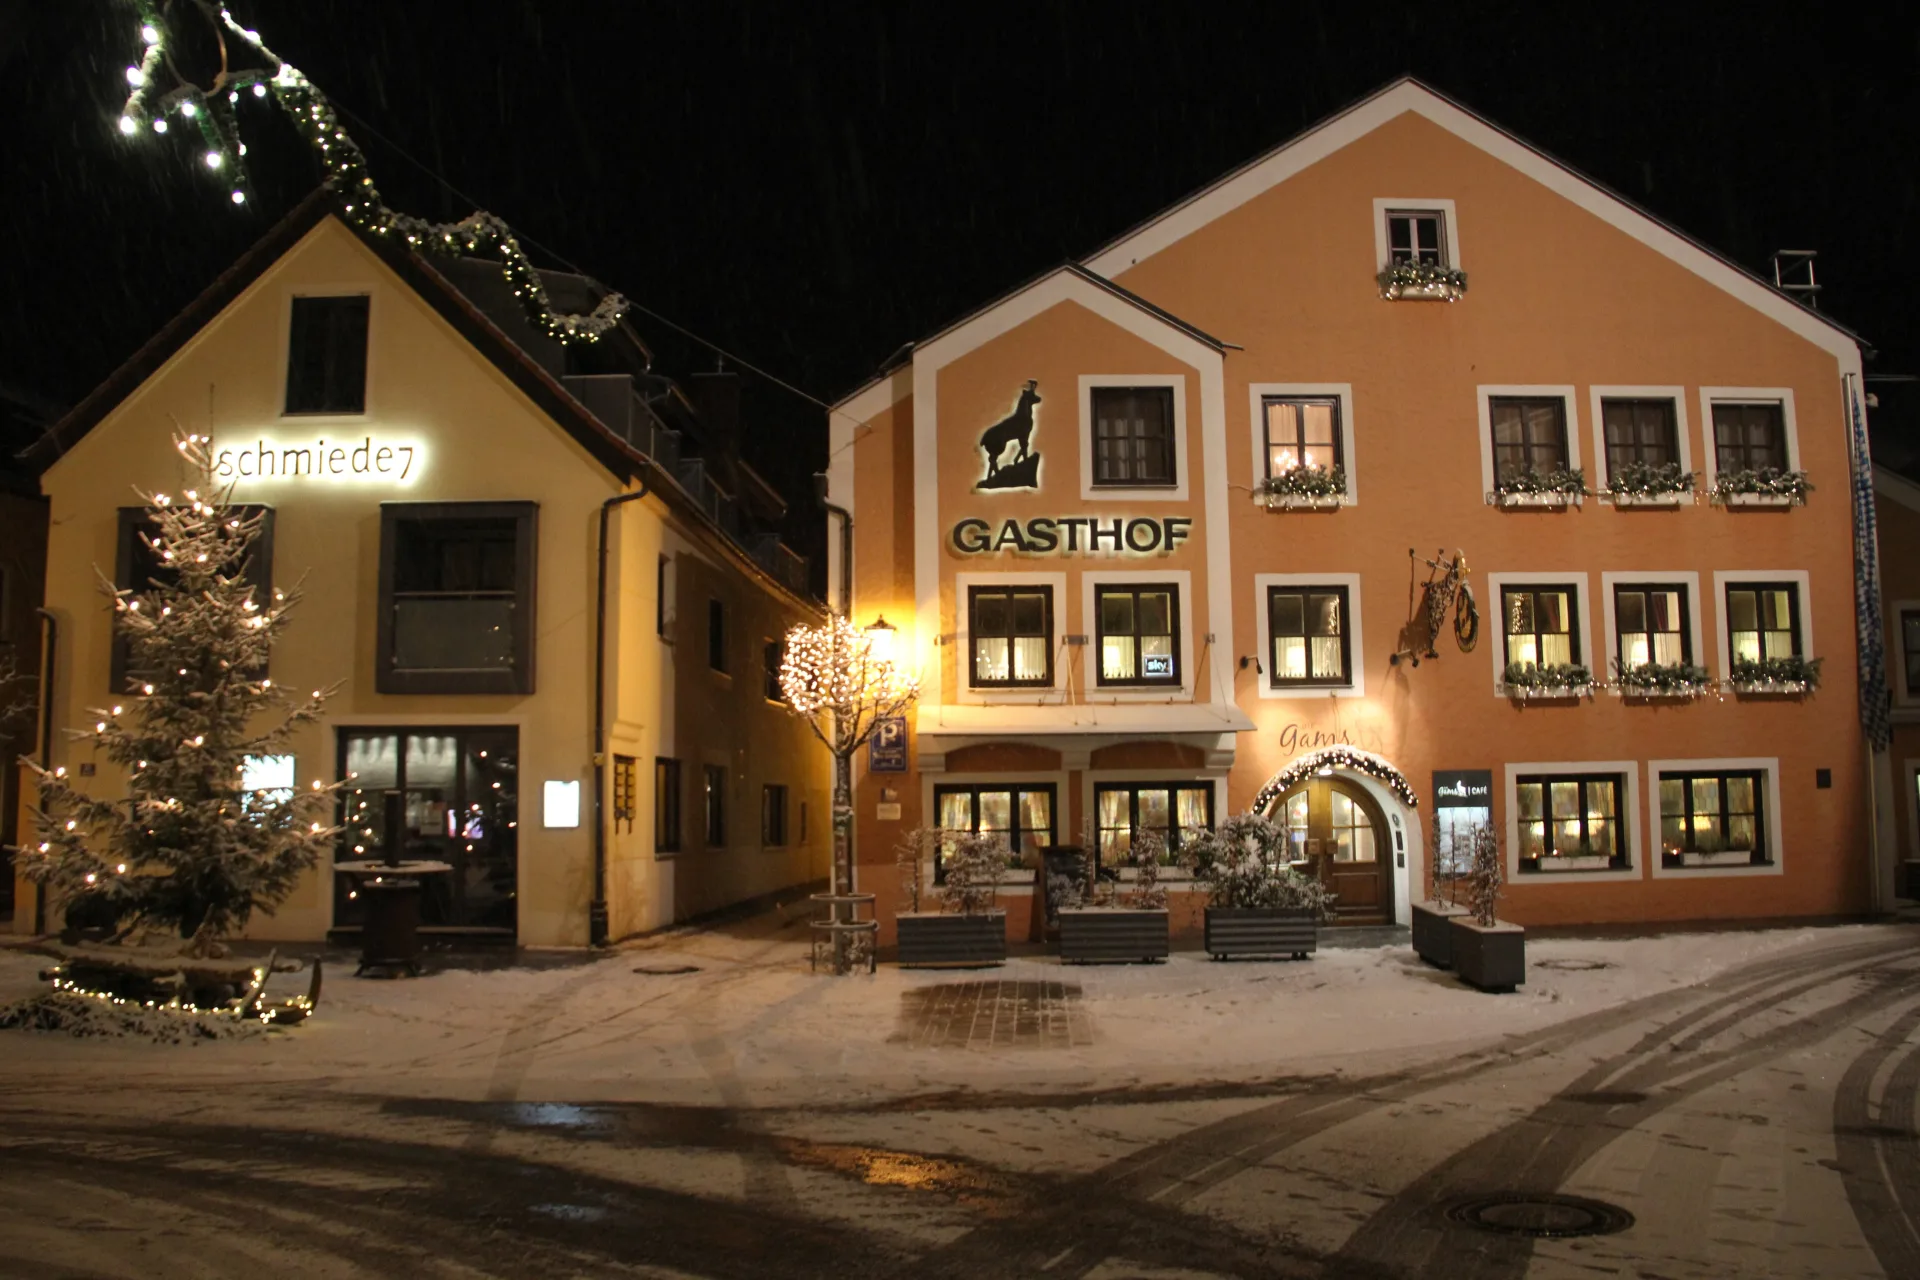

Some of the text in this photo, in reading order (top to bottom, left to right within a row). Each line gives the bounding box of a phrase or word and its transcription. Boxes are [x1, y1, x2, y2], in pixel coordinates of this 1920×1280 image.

[219, 437, 413, 479] schmiede7
[953, 518, 1192, 552] GASTHOF
[1147, 659, 1167, 672] sky
[880, 723, 898, 747] P
